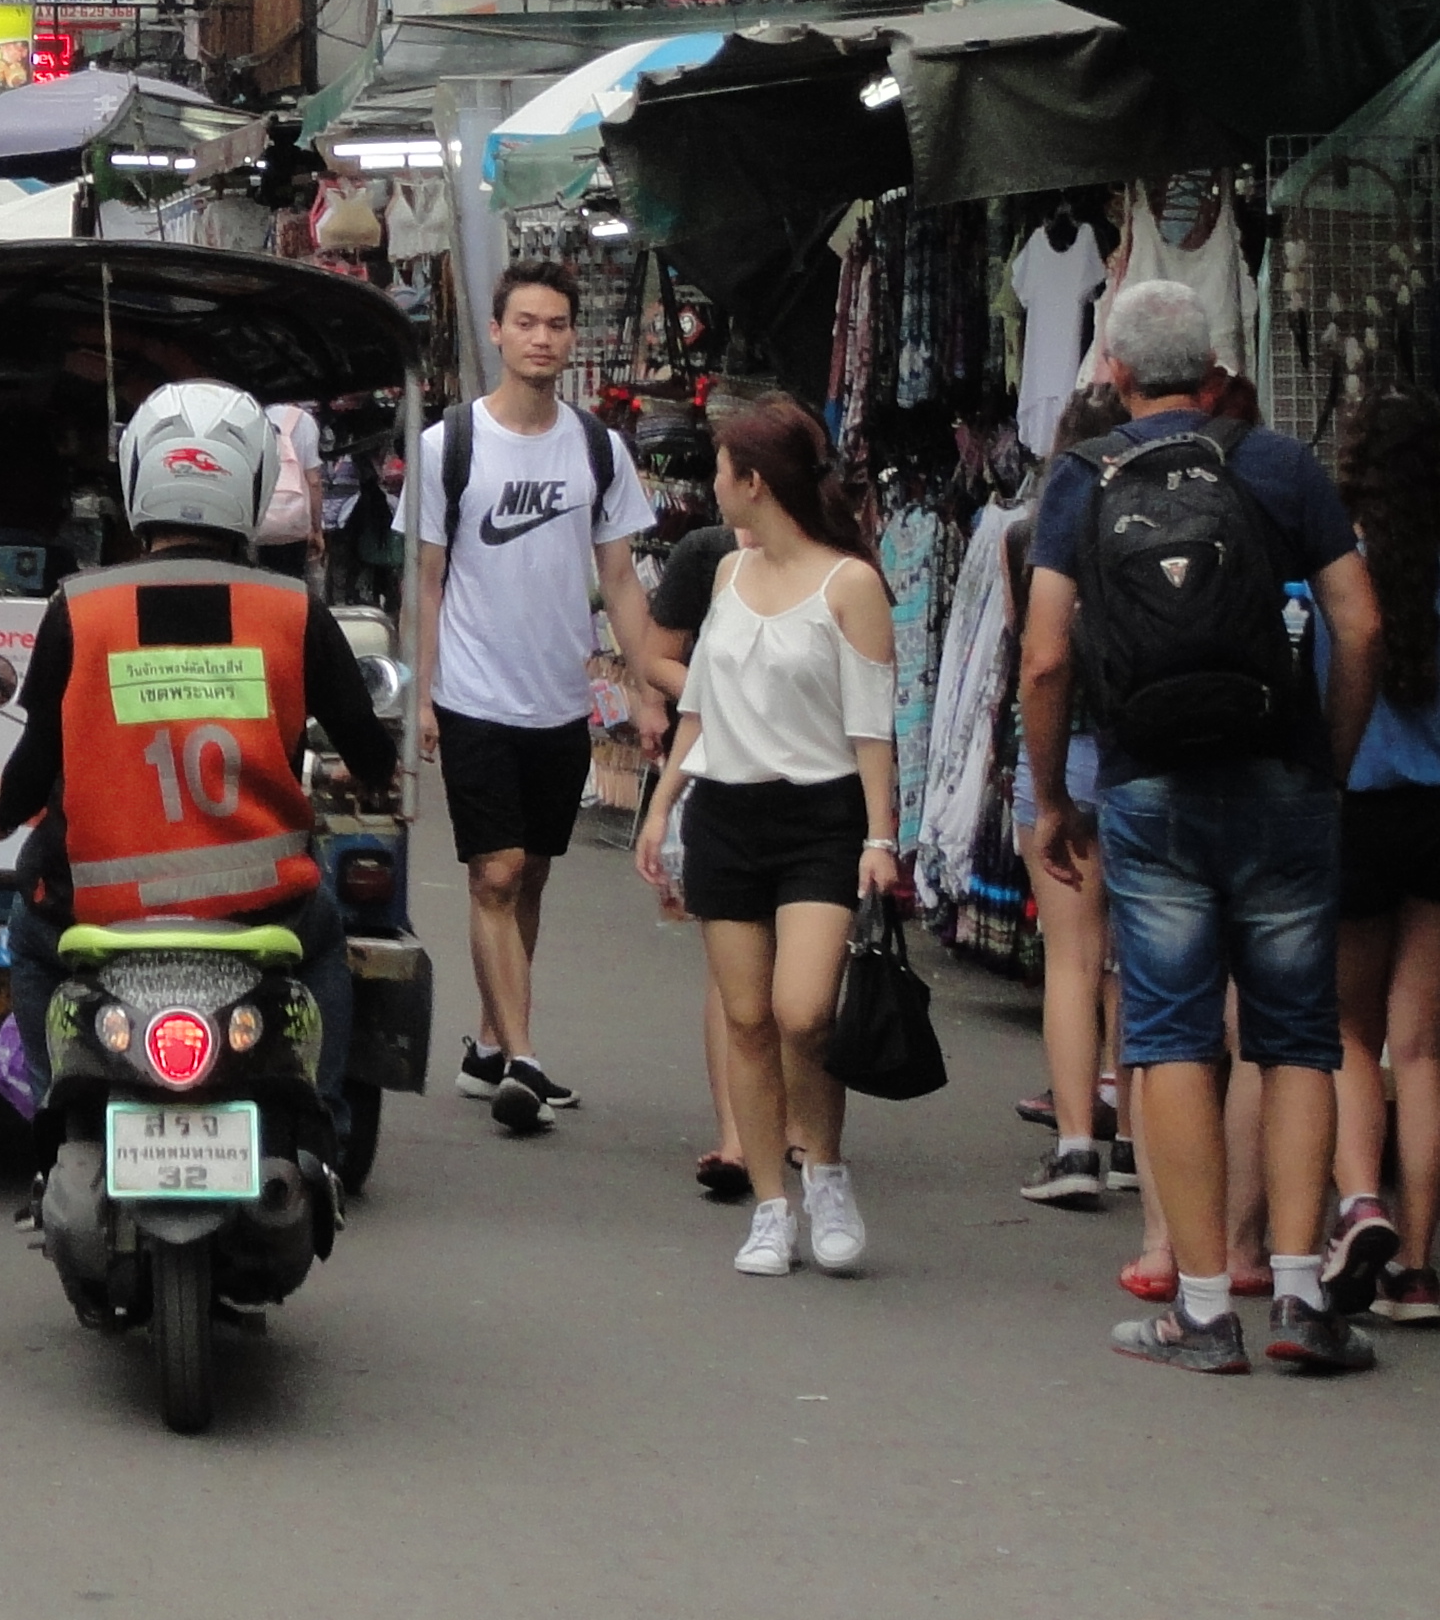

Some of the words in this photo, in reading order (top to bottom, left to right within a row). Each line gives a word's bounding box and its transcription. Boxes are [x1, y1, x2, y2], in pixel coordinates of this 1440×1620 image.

[496, 480, 568, 517] NIKE
[140, 685, 236, 703] เขตพระนคร
[143, 724, 242, 824] 10
[117, 1146, 249, 1164] กรุงเทพมหานคร
[157, 1165, 208, 1189] 32
